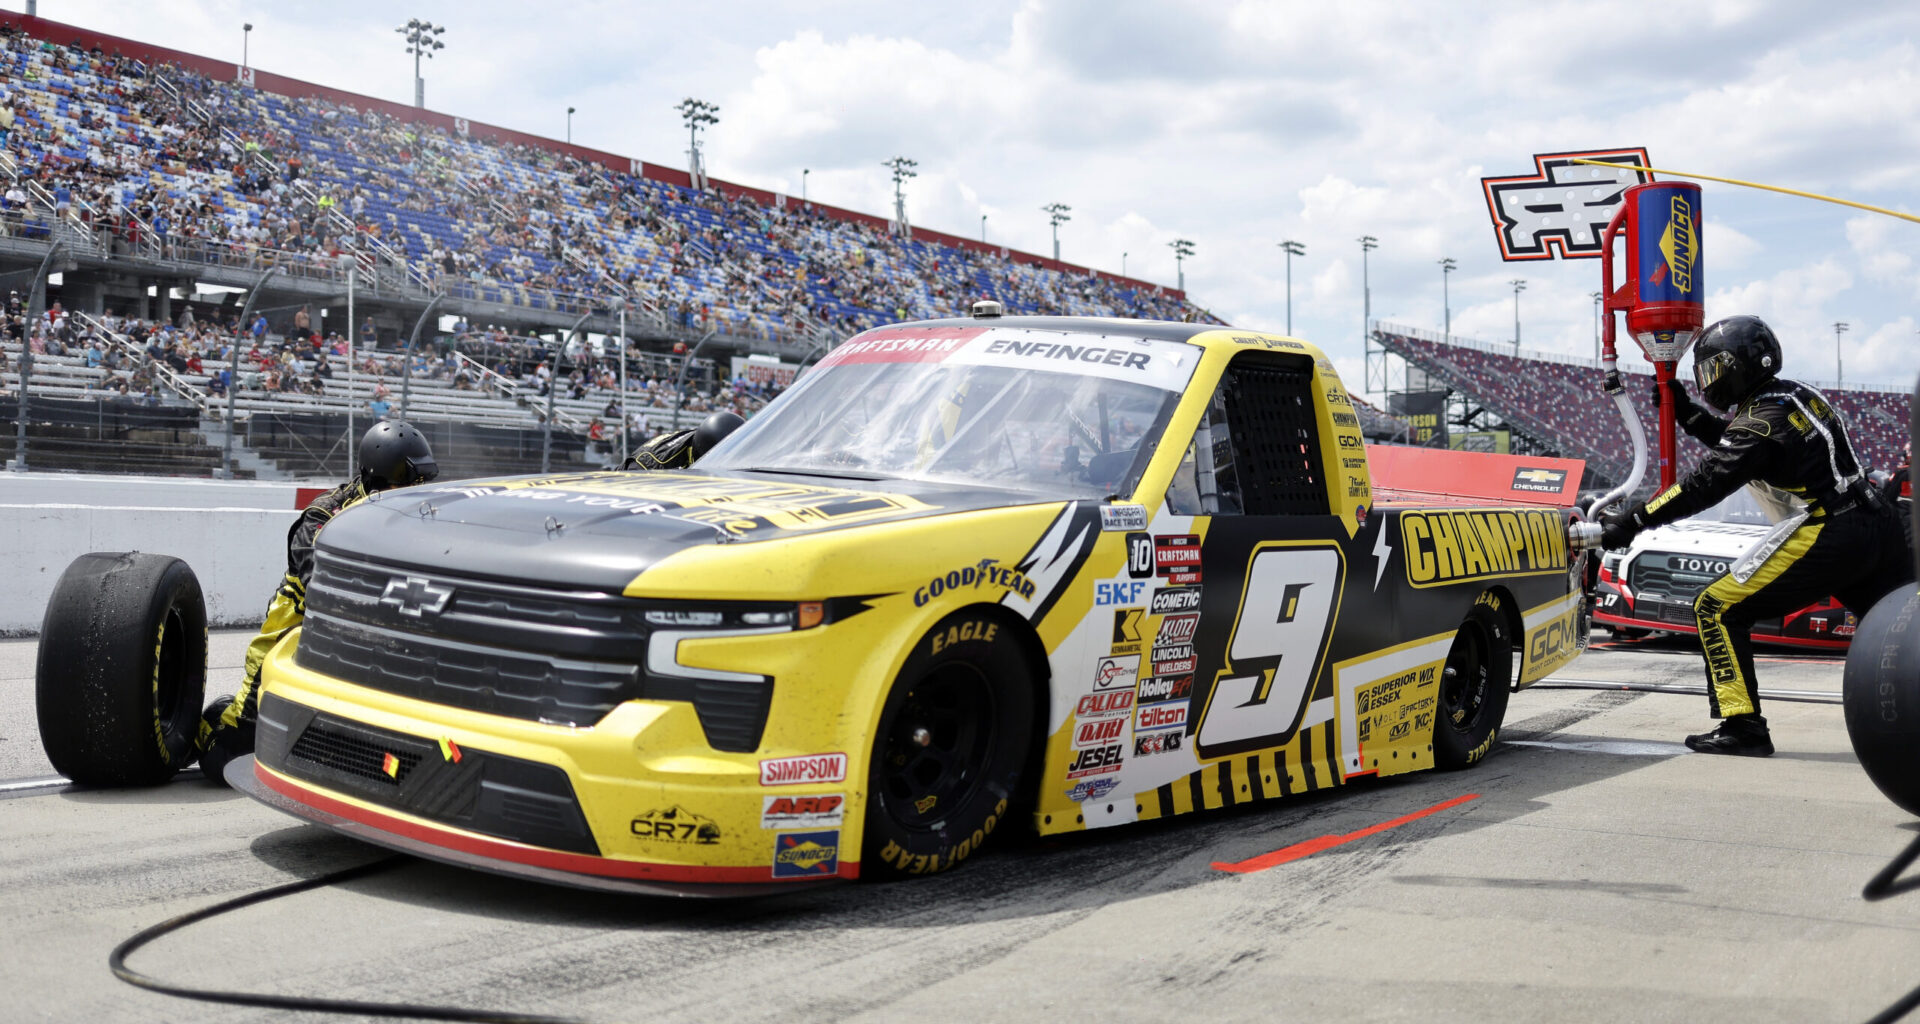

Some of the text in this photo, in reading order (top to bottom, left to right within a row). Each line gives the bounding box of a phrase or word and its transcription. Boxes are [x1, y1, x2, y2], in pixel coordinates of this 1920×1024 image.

[241, 68, 251, 81] R
[1673, 197, 1691, 291] SUNOCO
[983, 339, 1152, 371] ENFINGER
[1339, 435, 1363, 447] GCM
[1513, 483, 1561, 492] CHEVROLET
[1645, 484, 1682, 514] CHAMPION
[1104, 517, 1144, 527] RACE TRUCK
[1132, 539, 1152, 572] 10
[1157, 550, 1200, 562] CRAFTSMAN
[1403, 510, 1566, 583] CHAMPION
[913, 563, 1036, 608] GOODYEAR
[1096, 582, 1146, 606] SKF
[1153, 589, 1200, 609] COMETIC
[1604, 594, 1618, 606] 17
[1160, 617, 1195, 637] KLOTZ
[1529, 612, 1575, 664] GCM
[931, 621, 998, 656] EAGLE
[1152, 646, 1191, 661] LINCOLN
[1197, 548, 1340, 752] 9
[1158, 661, 1192, 673] WELDERS
[1139, 679, 1174, 699] Holley
[1371, 667, 1436, 698] SUPERIOR WIX
[1076, 691, 1135, 715] CALICO
[1371, 689, 1401, 710] ESSEX
[1140, 707, 1186, 727] tilton
[1466, 728, 1496, 764] EAGLE
[1069, 744, 1124, 772] JESEL
[766, 757, 840, 783] SIMPSON
[765, 796, 843, 815] ARP
[631, 819, 698, 840] CR7
[879, 797, 1008, 874] GOODYEAR
[780, 847, 835, 862] SUNOCO
